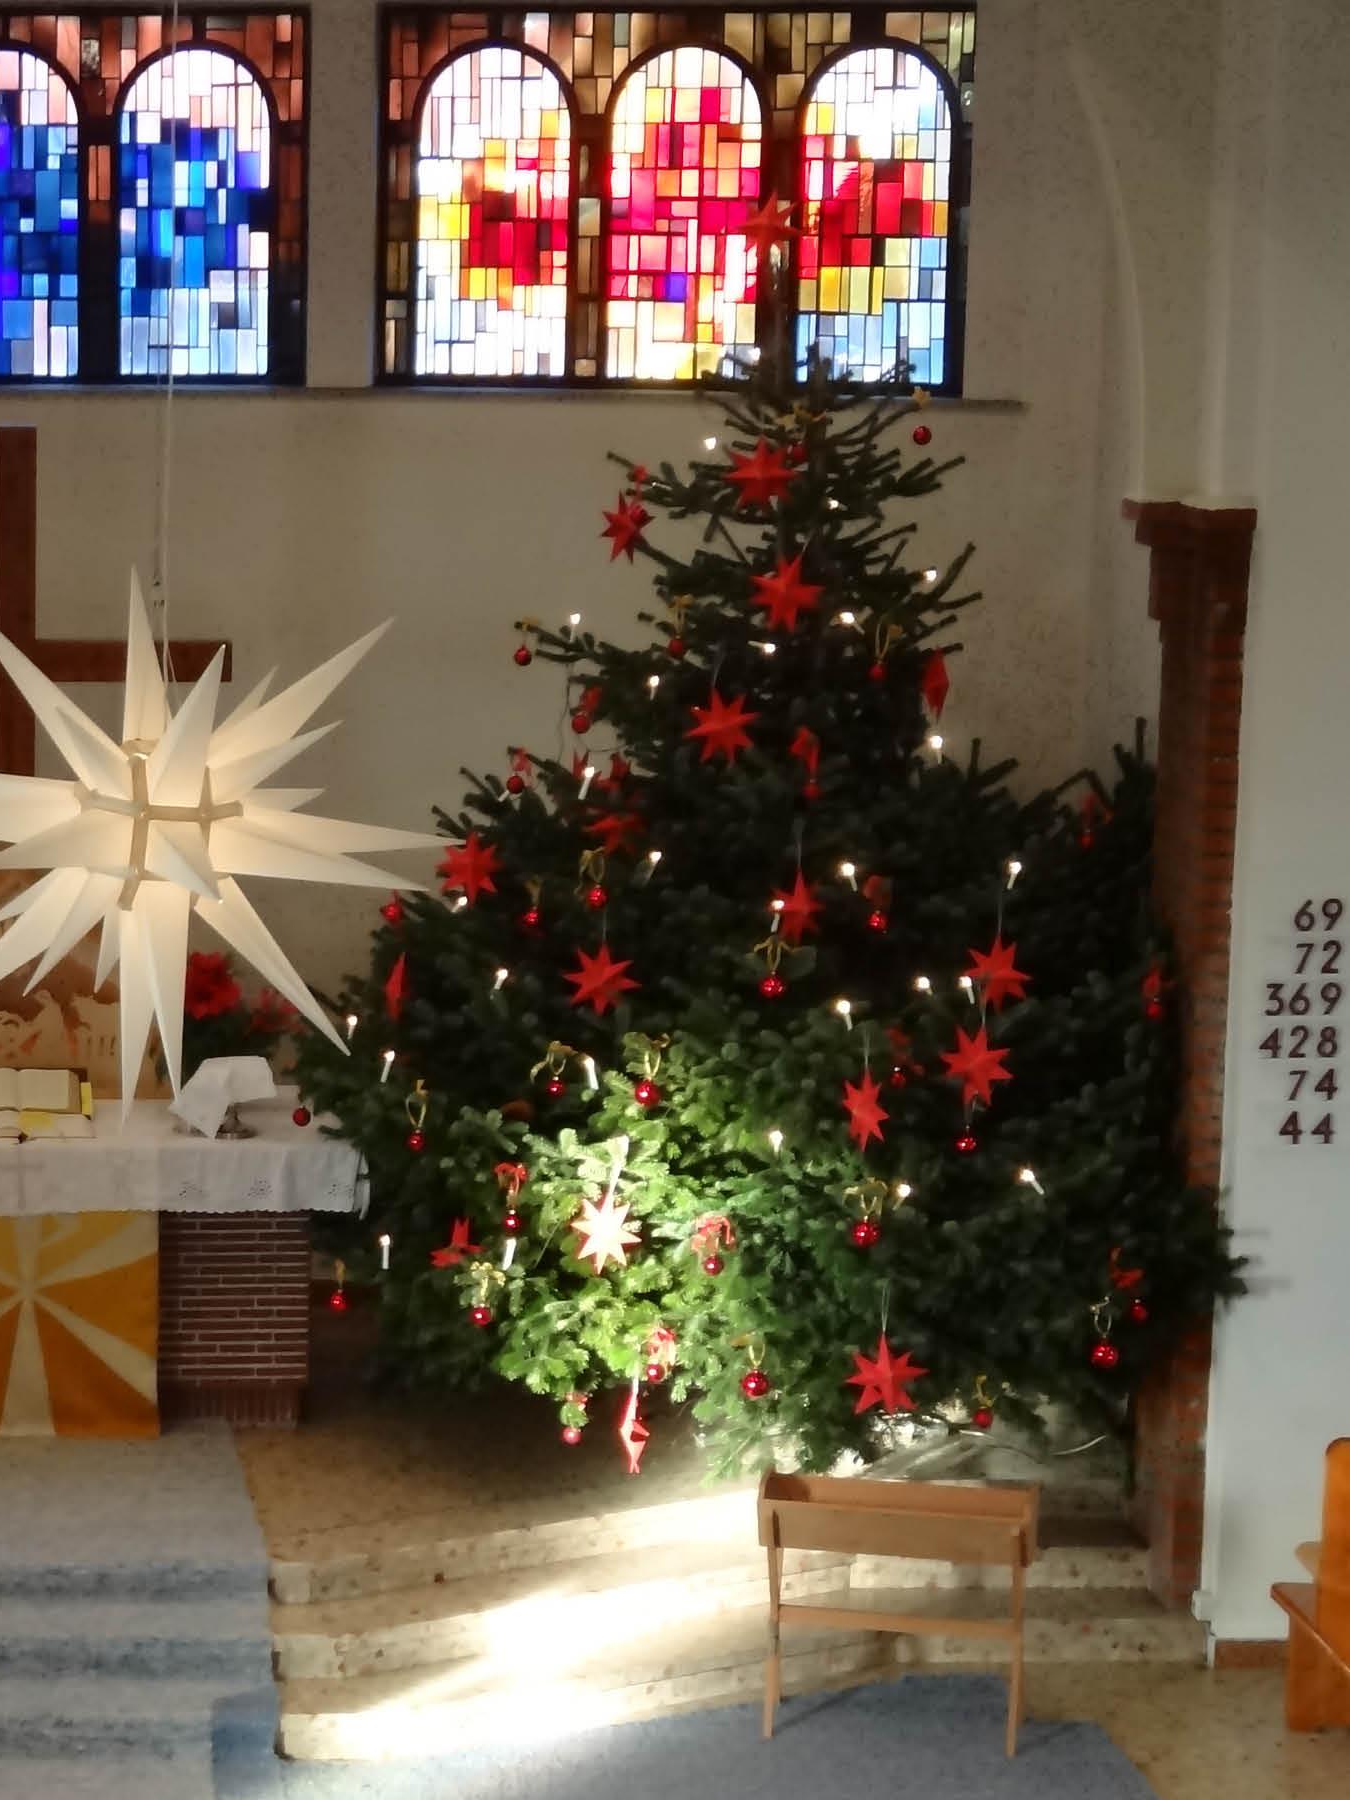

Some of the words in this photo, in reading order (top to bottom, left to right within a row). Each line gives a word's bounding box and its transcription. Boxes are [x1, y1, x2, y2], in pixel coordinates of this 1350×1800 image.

[1294, 898, 1343, 932] 69
[1294, 940, 1342, 974] 72
[1264, 982, 1342, 1016] 369
[1258, 1025, 1338, 1059] 428
[1287, 1068, 1338, 1101] 74
[1278, 1111, 1334, 1145] 44
